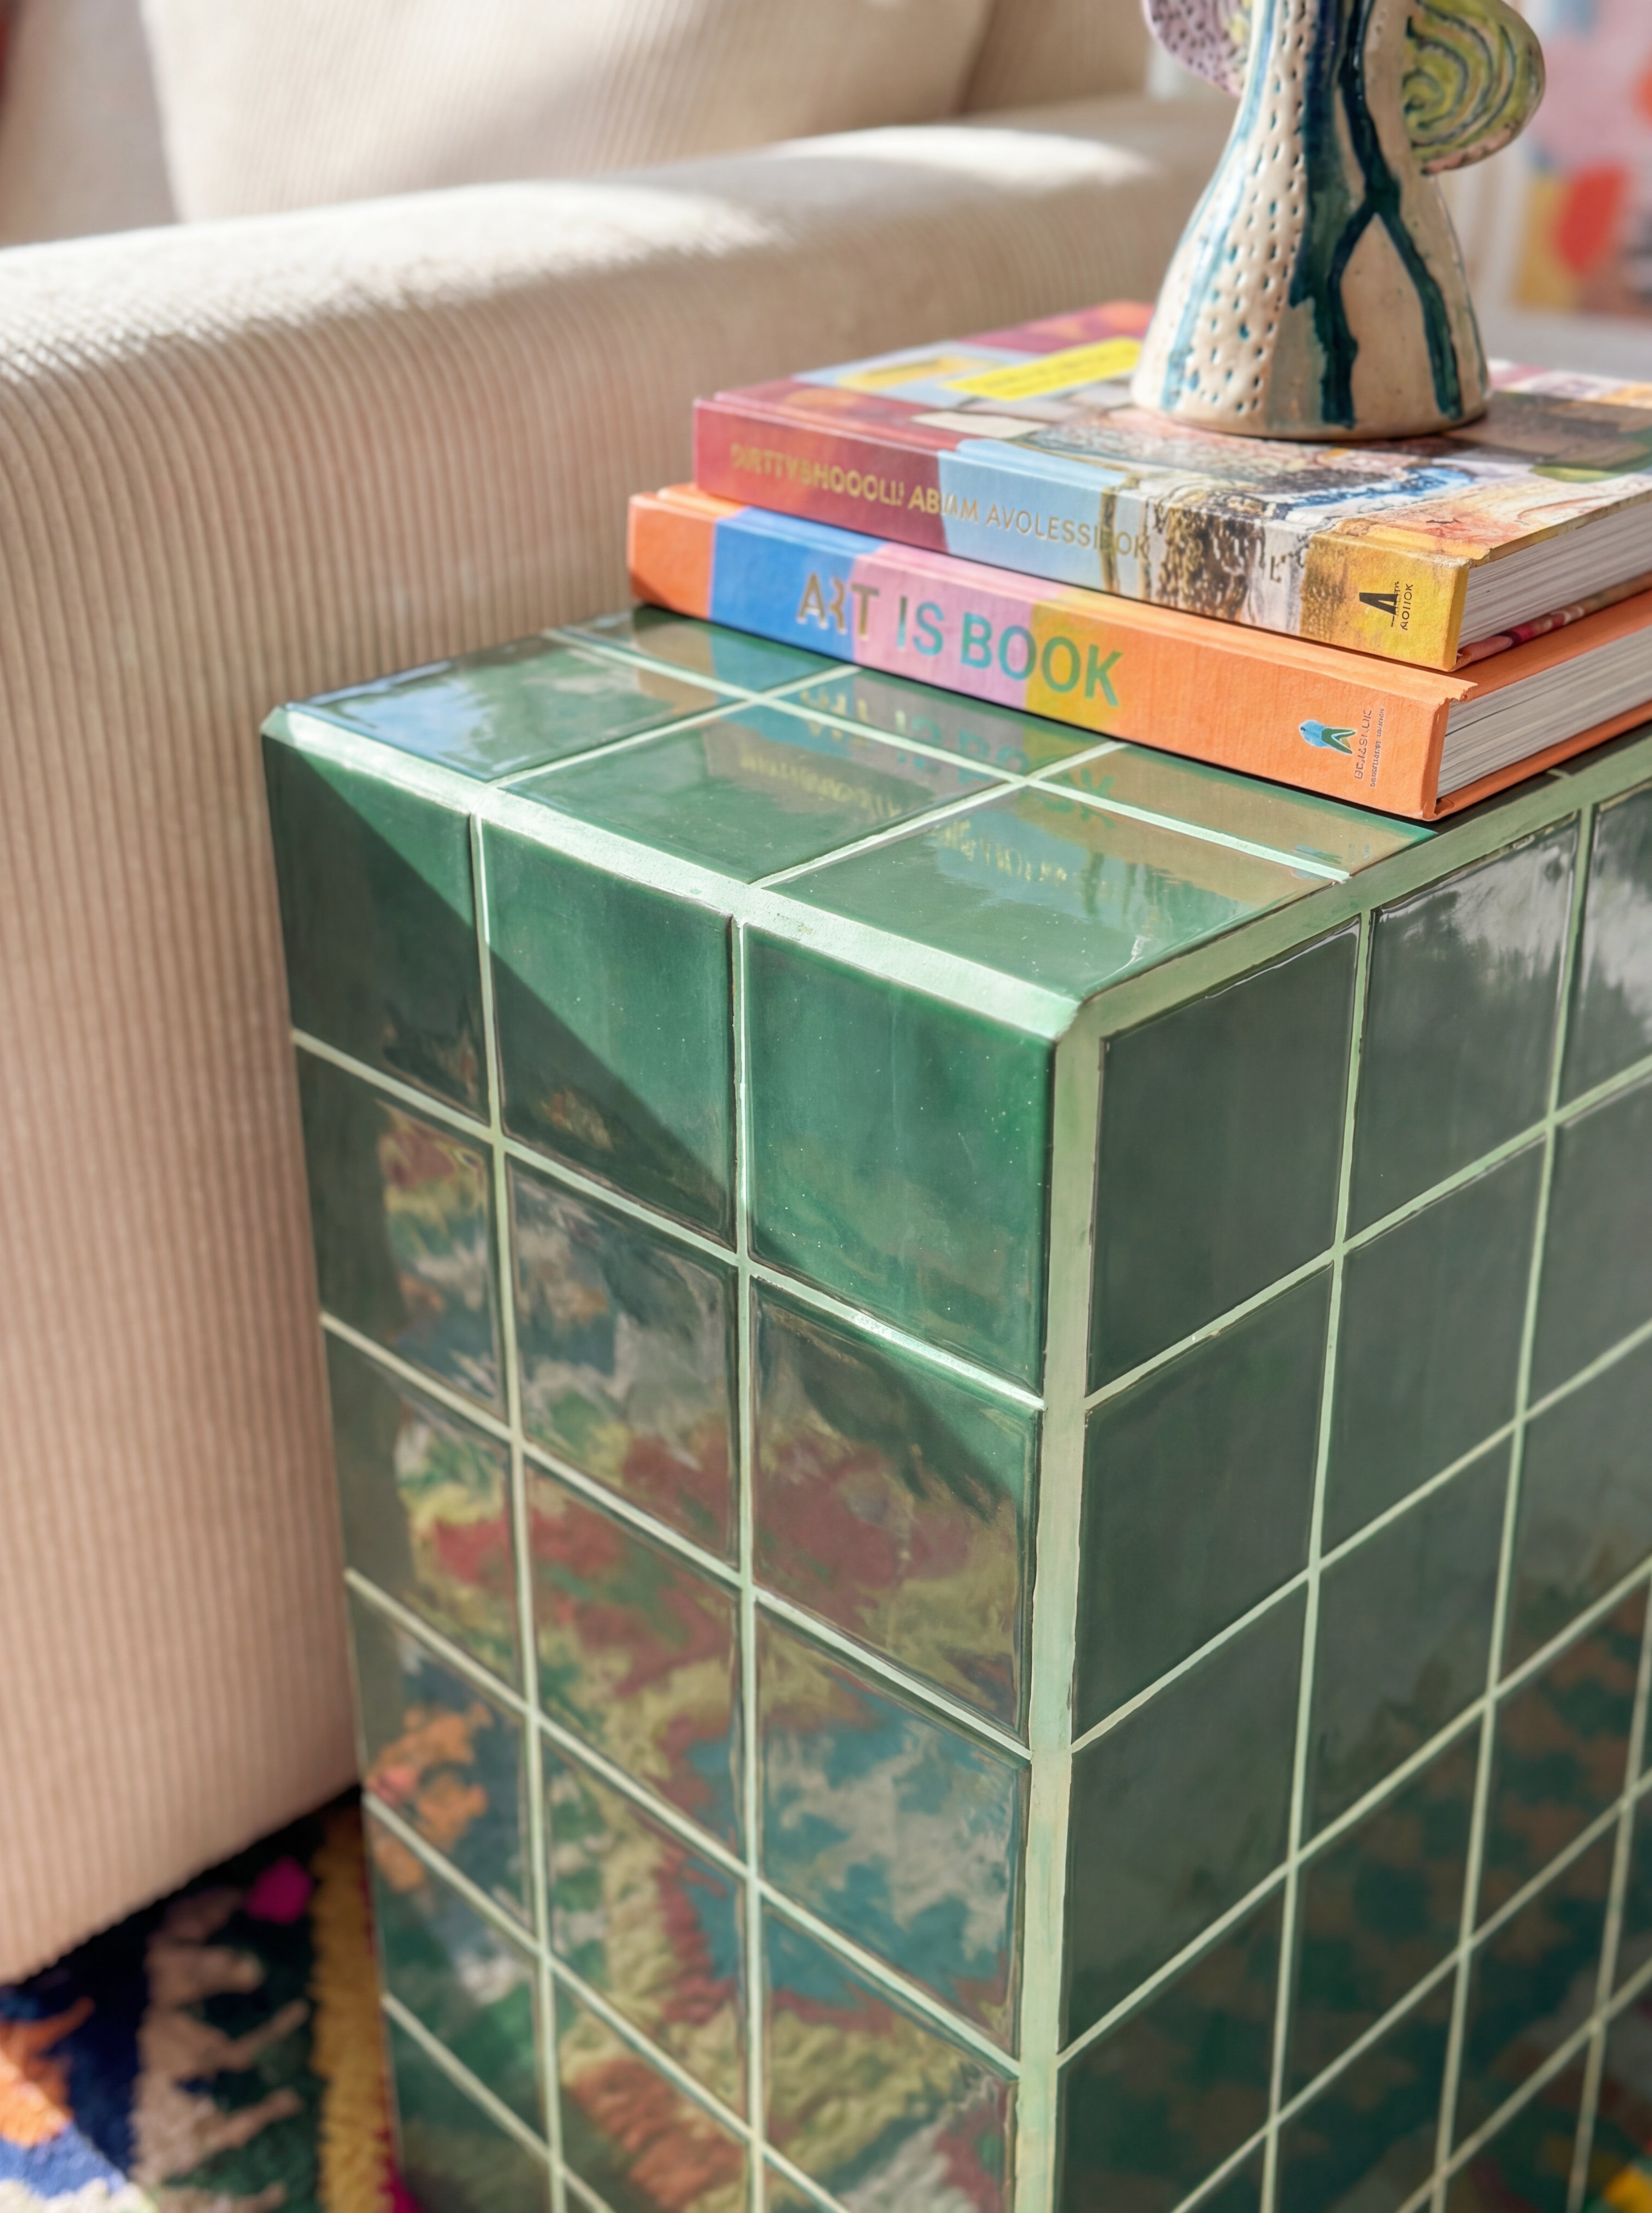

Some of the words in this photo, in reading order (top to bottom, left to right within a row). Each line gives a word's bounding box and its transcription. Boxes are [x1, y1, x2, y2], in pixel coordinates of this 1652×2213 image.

[796, 573, 879, 641] ART
[895, 595, 944, 657] IS
[960, 612, 1124, 707] BOOK
